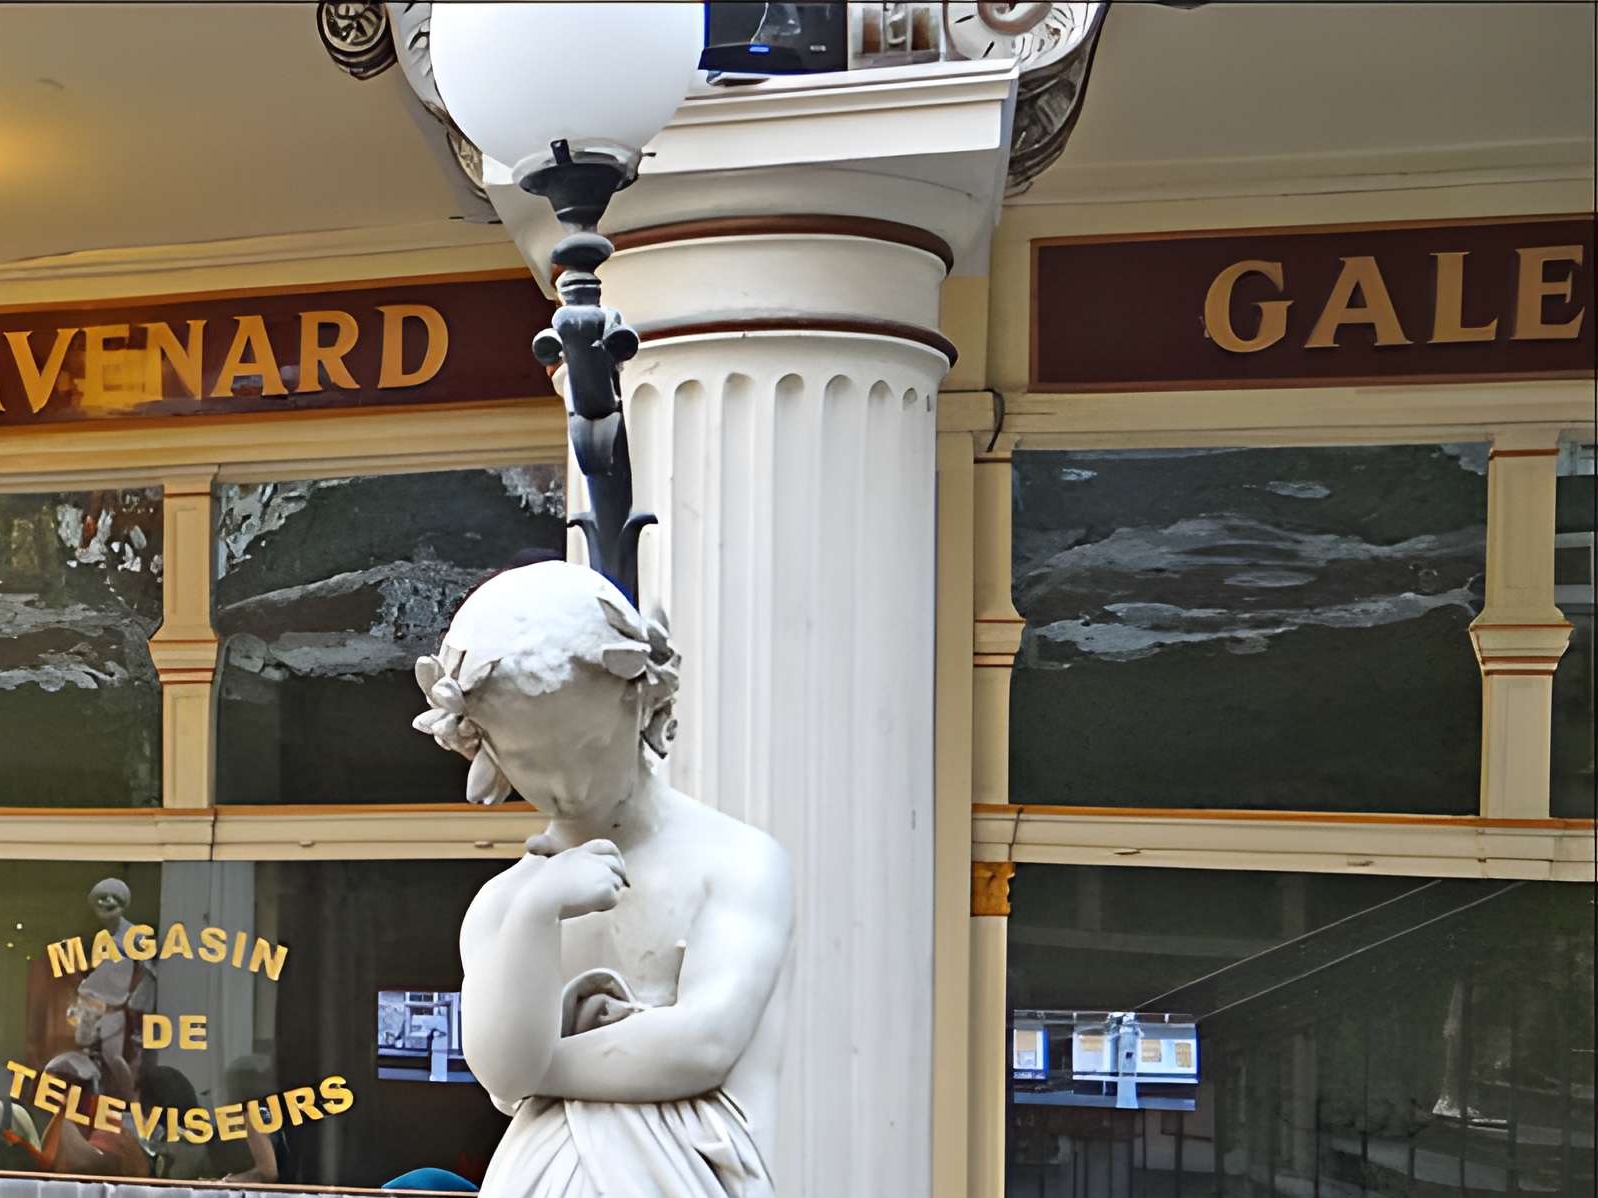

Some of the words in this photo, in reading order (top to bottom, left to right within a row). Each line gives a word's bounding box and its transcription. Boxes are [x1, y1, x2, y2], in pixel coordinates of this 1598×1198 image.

[1203, 244, 1586, 354] GALE
[46, 921, 289, 982] MAGASIN
[142, 1014, 208, 1050] DE
[5, 1060, 355, 1145] TELEVISEURS
